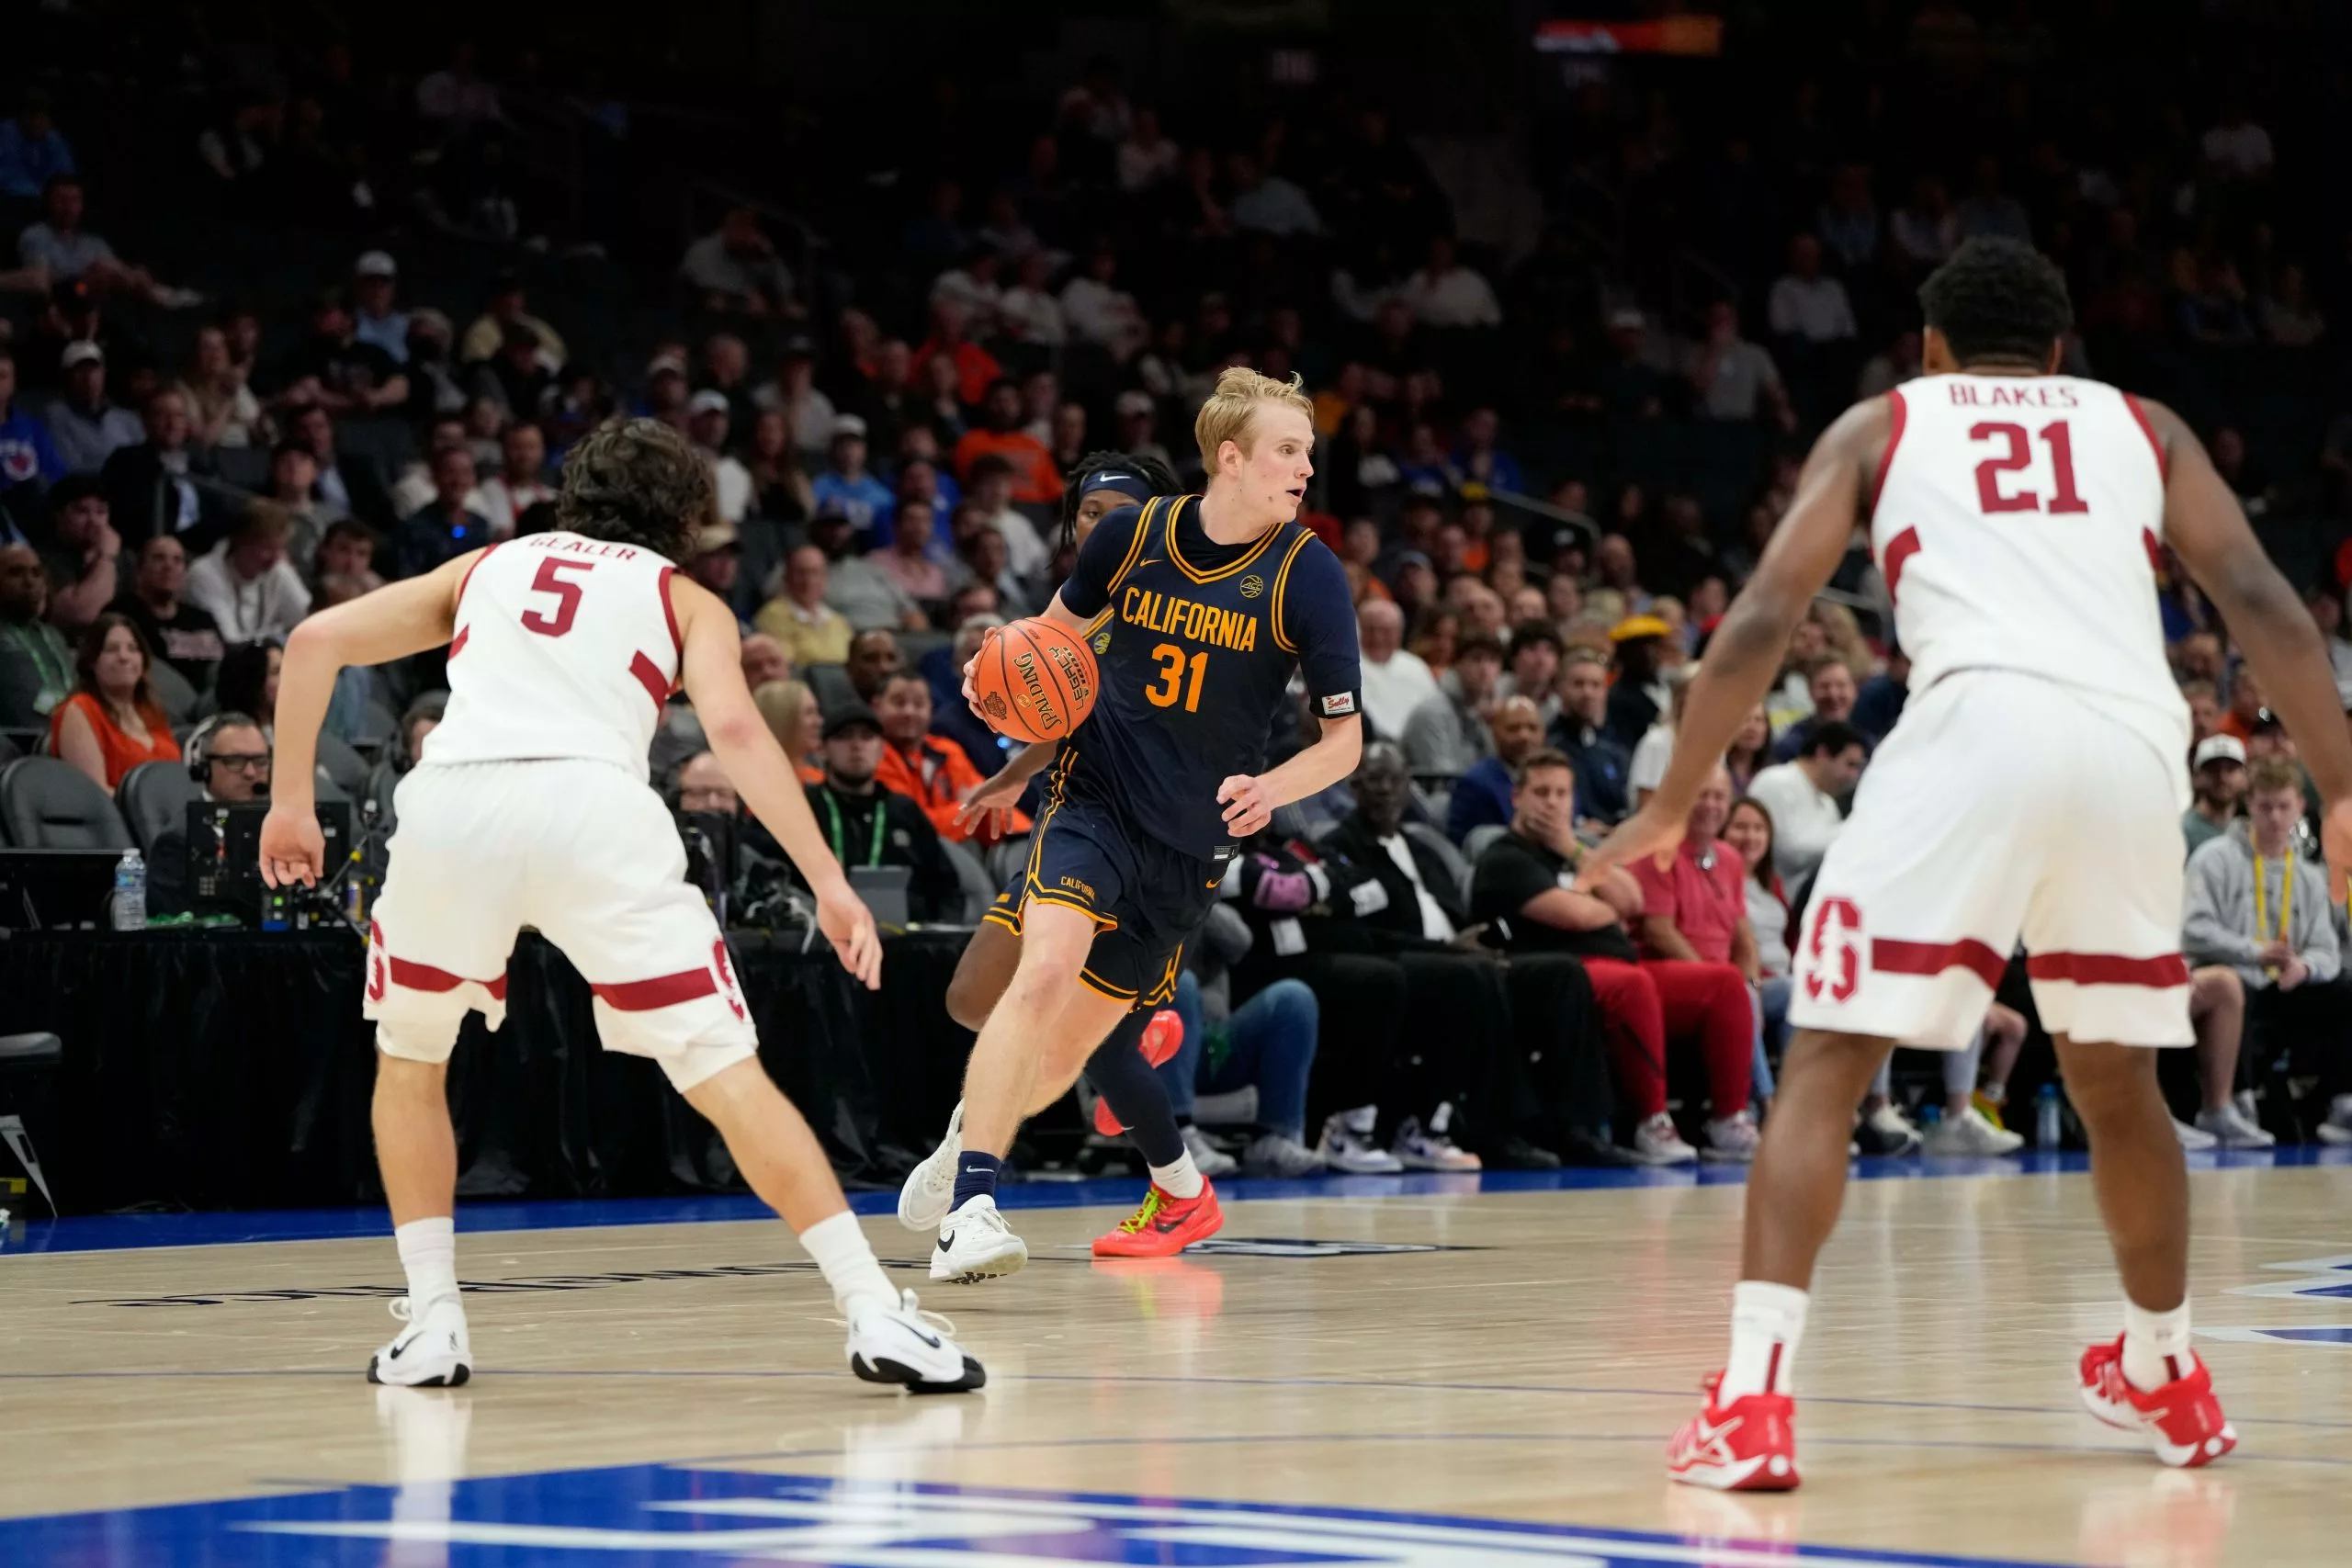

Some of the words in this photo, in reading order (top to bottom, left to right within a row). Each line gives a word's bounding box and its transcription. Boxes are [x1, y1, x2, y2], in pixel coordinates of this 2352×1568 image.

[1949, 383, 2078, 407] BLAKES
[1969, 419, 2089, 514] 21
[521, 556, 595, 637] 5
[1122, 586, 1259, 652] CALIFORNIA
[1013, 651, 1063, 730] SPALDING
[1047, 646, 1084, 711] LEGACY
[1145, 643, 1209, 713] 31
